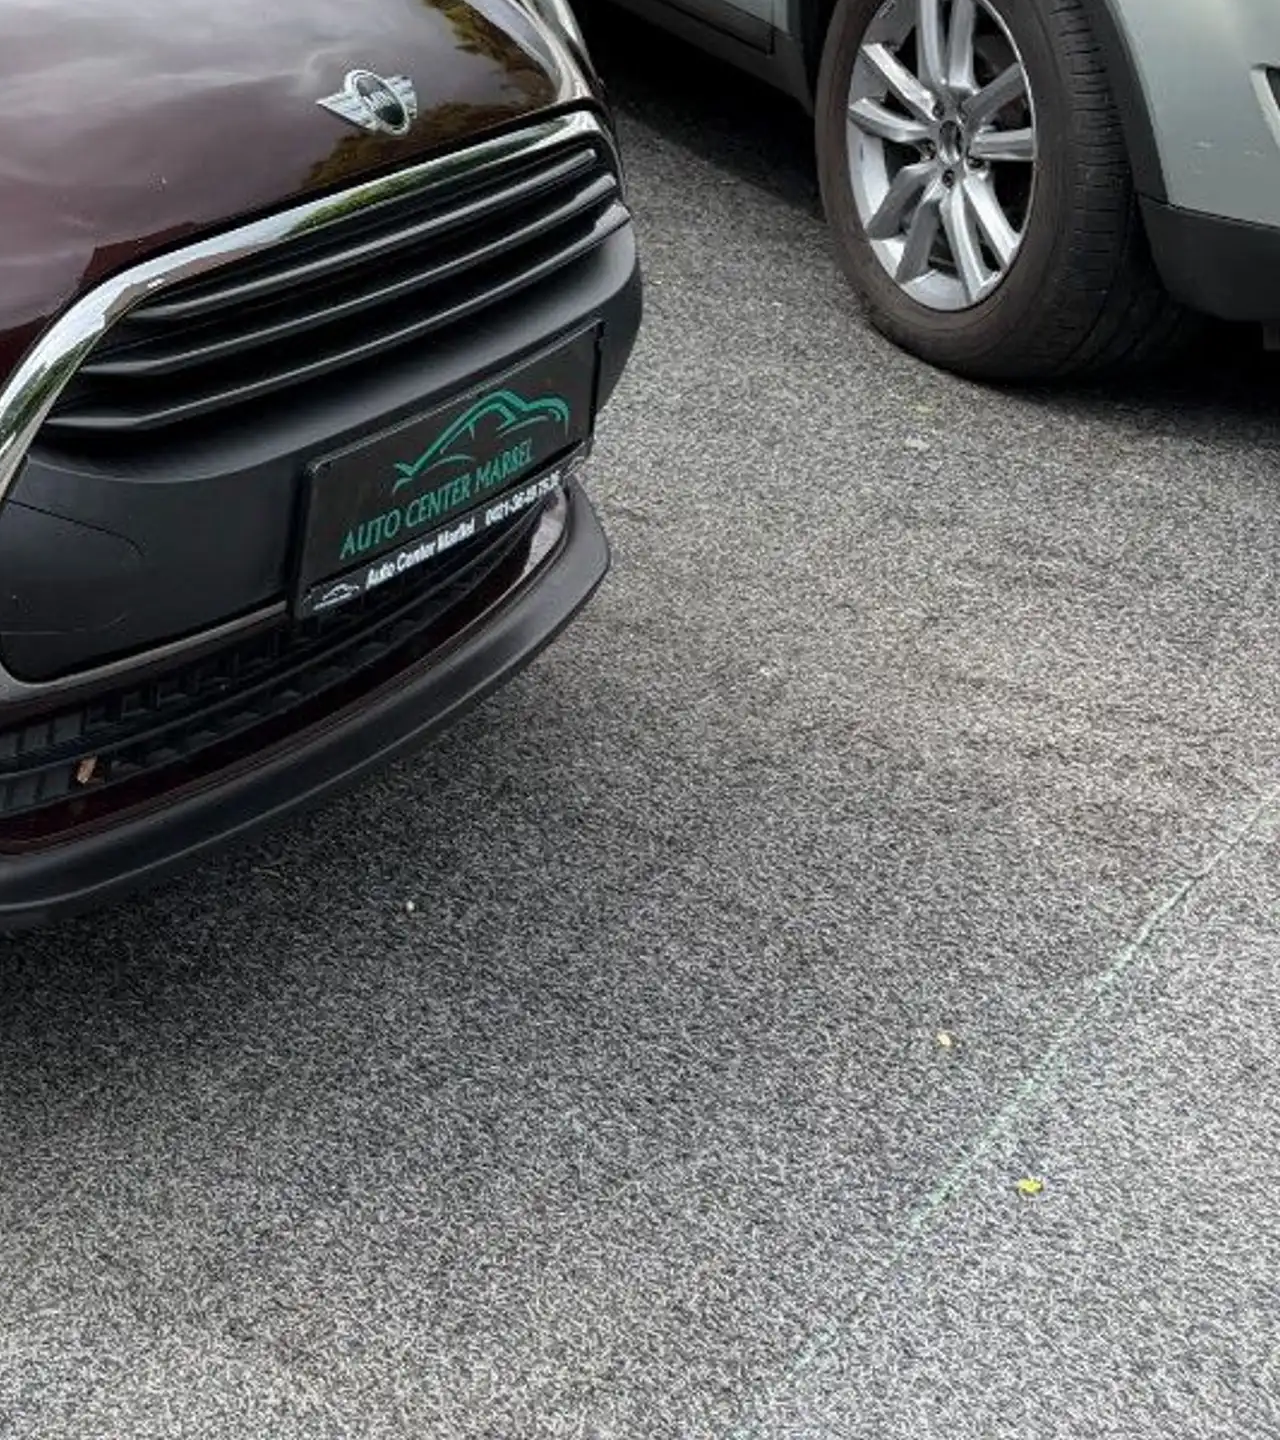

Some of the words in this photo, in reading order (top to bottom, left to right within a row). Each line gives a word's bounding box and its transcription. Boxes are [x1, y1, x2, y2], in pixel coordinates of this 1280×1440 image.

[339, 509, 401, 559] AUTO
[404, 474, 471, 528] CENTER
[366, 563, 396, 590] Auto
[397, 540, 437, 573] Center
